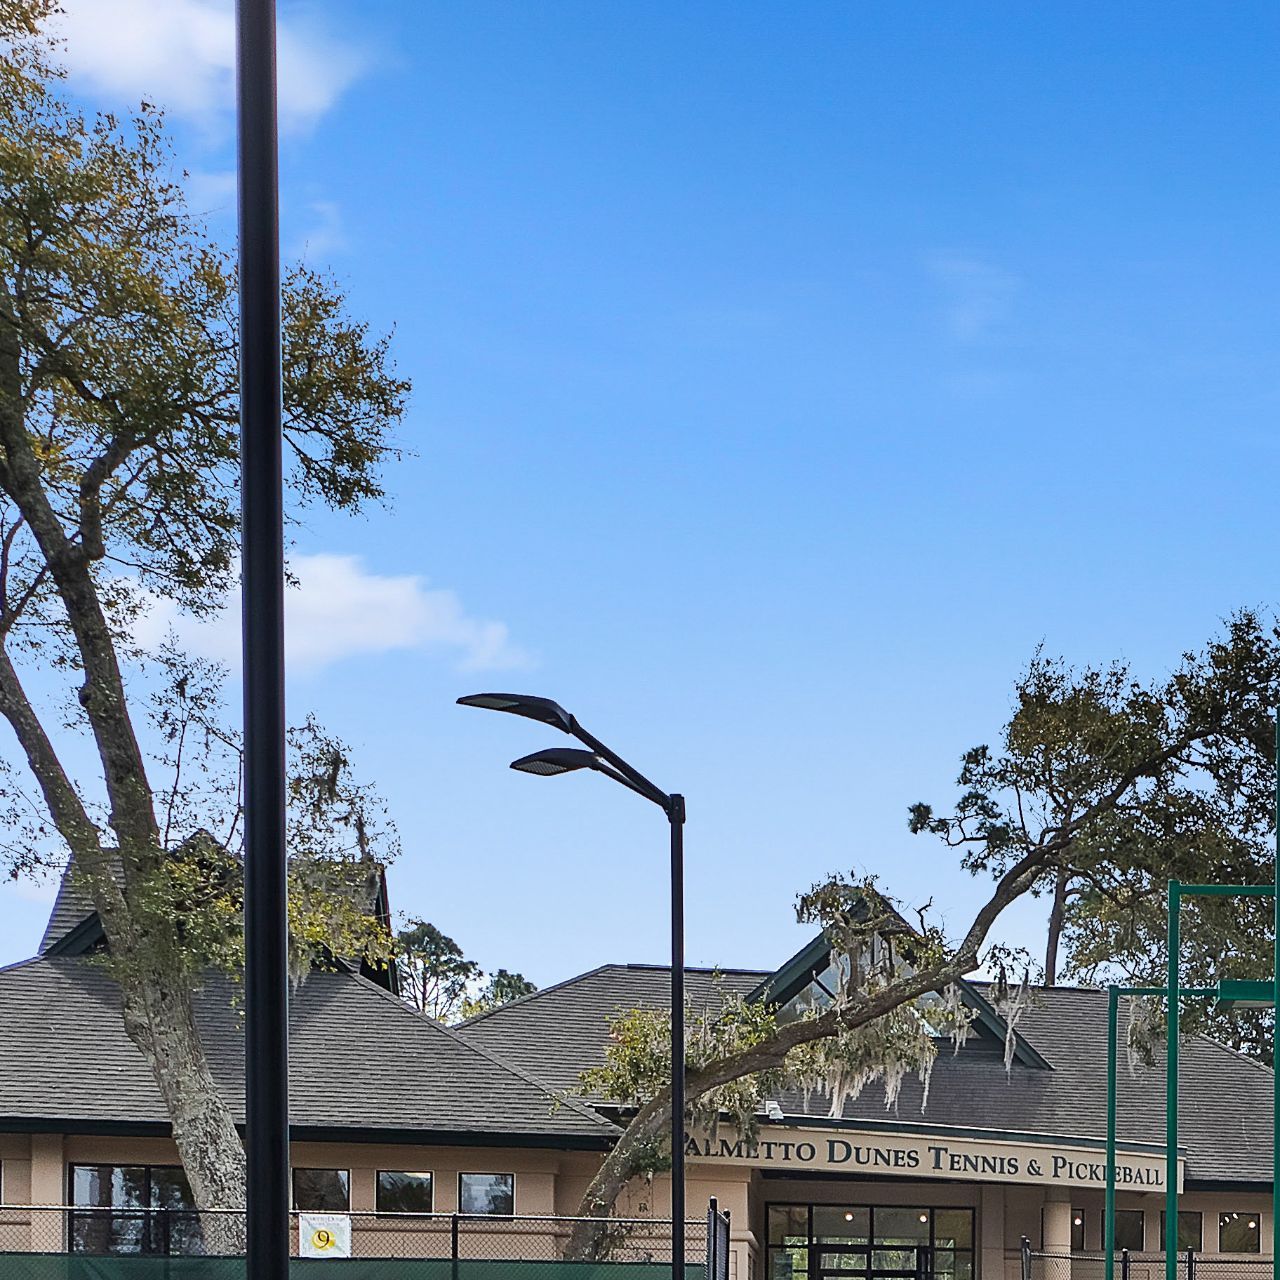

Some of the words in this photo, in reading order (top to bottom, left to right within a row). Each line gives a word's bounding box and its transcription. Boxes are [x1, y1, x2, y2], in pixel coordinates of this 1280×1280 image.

[684, 1132, 816, 1162] ALMETTO
[826, 1139, 920, 1168] DUNES
[928, 1146, 1019, 1175] TENNIS
[1027, 1159, 1044, 1176] &
[317, 1230, 330, 1249] 9
